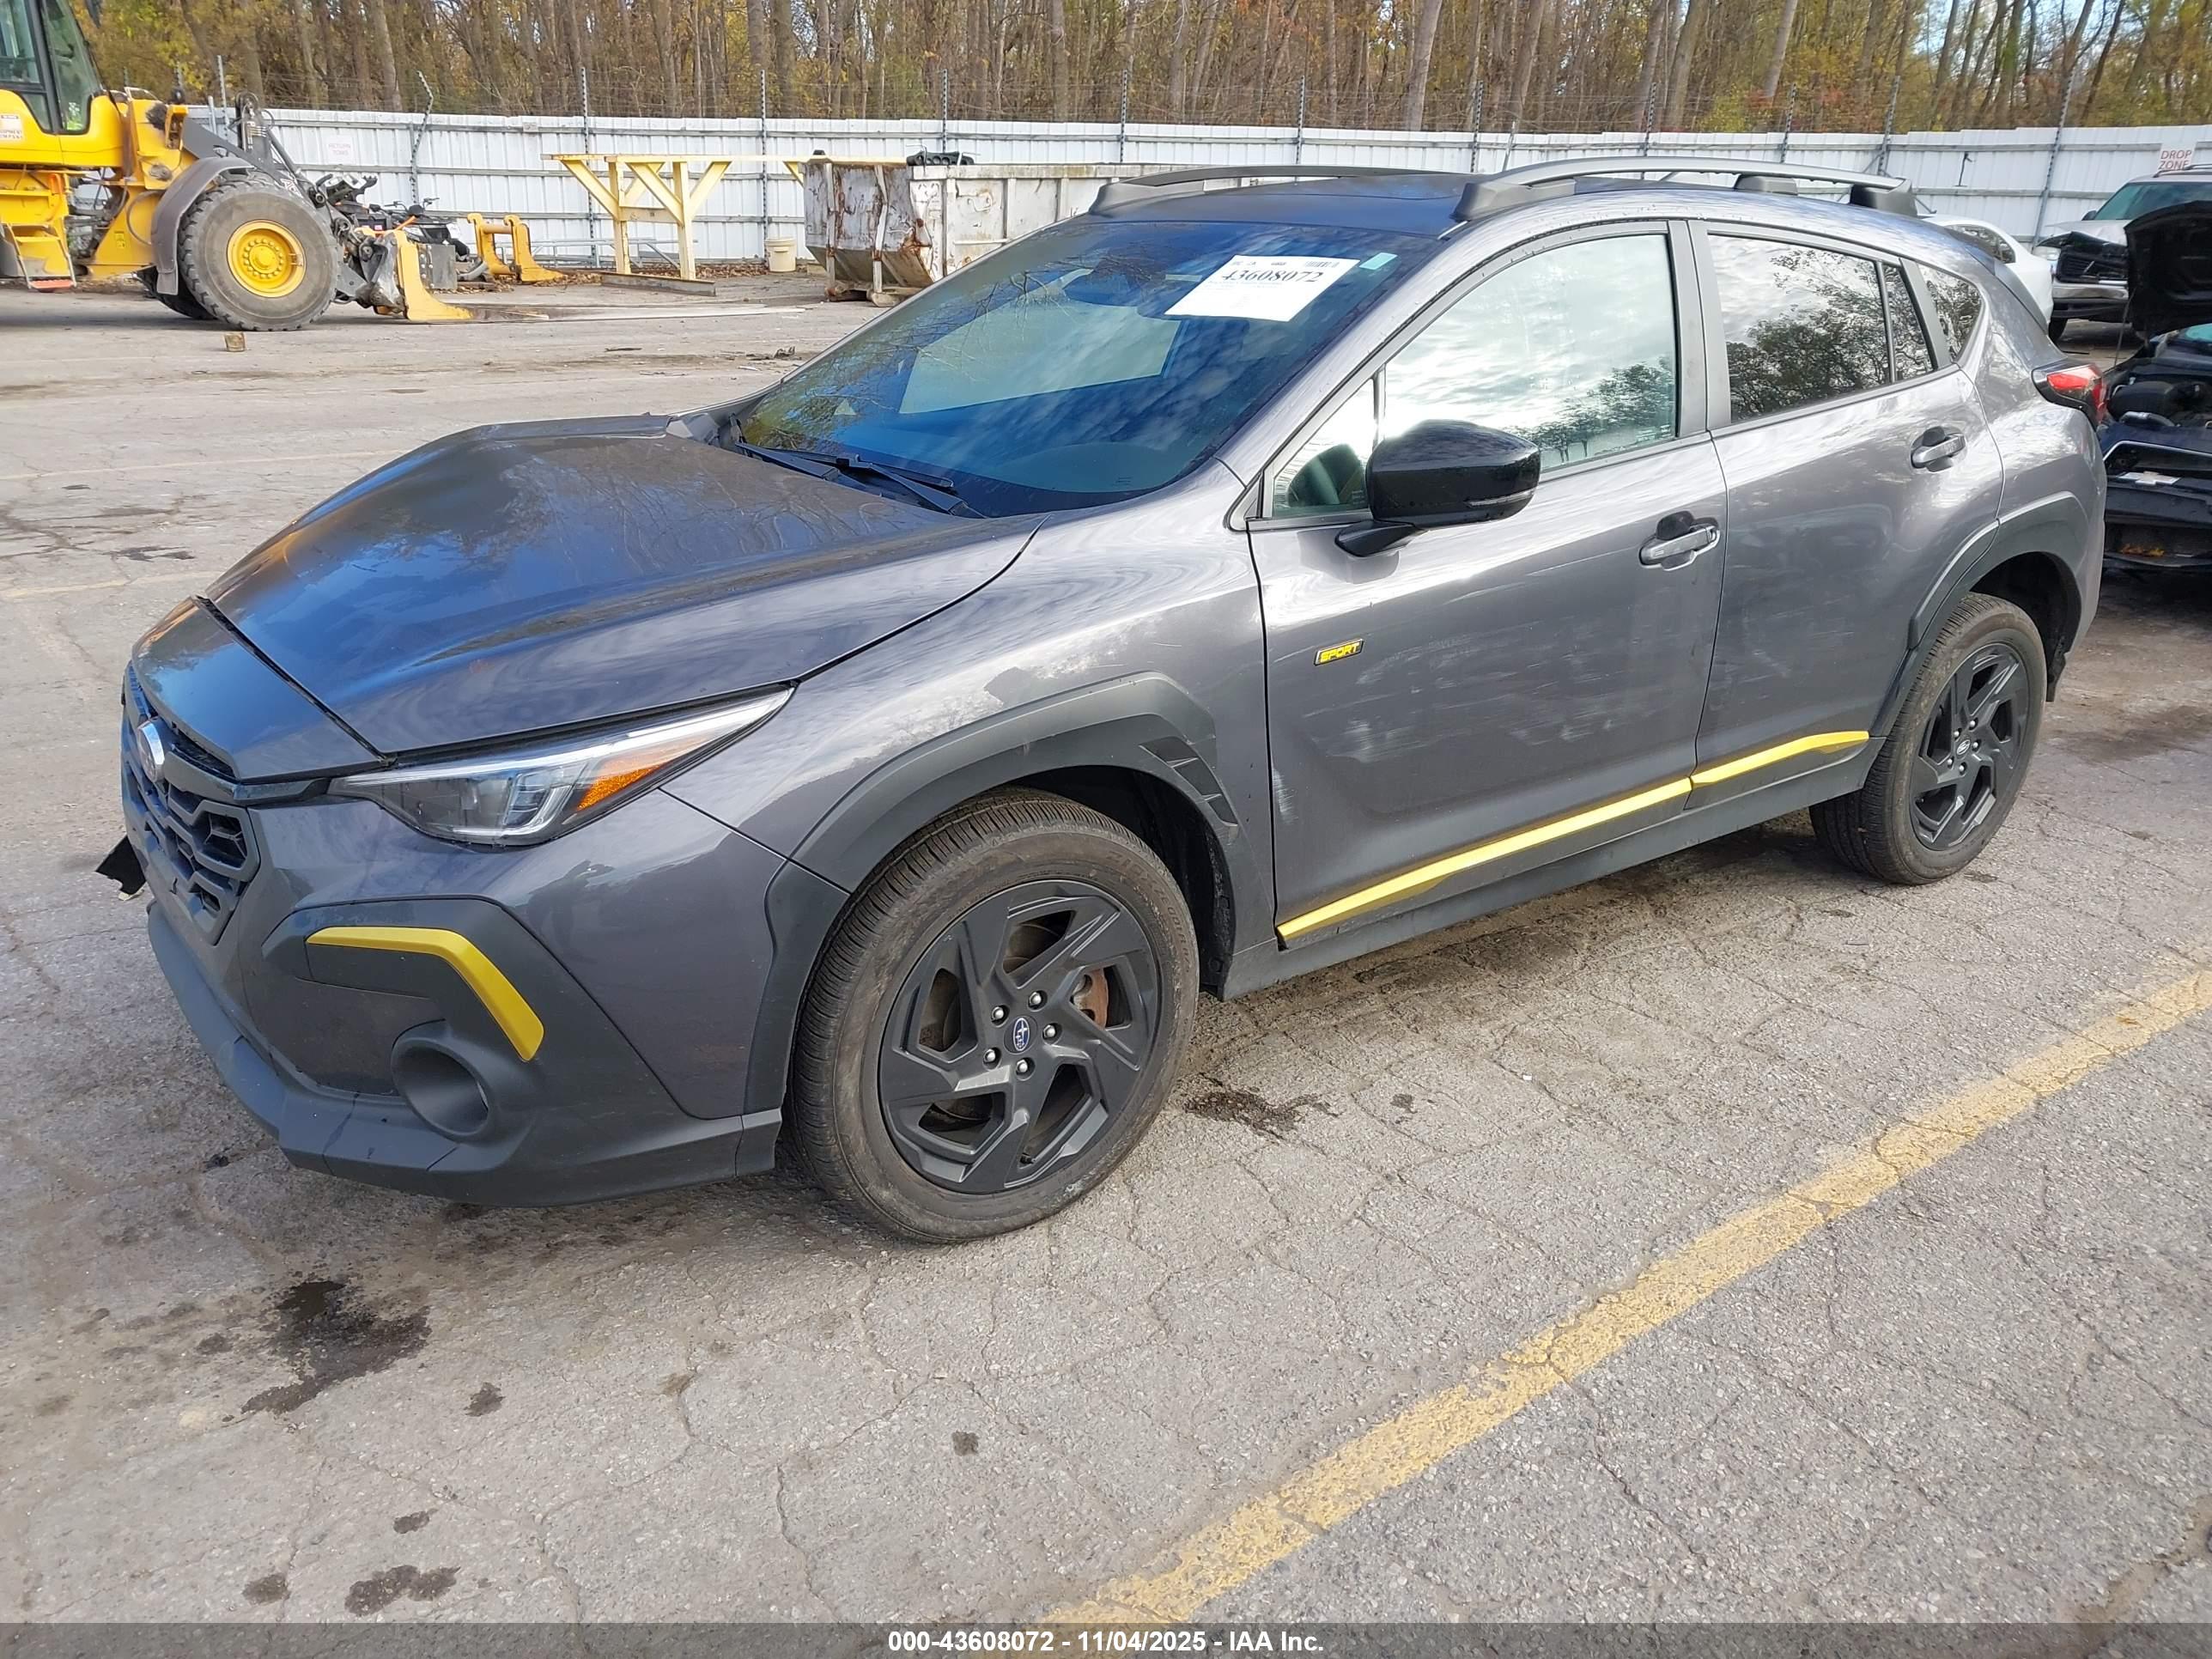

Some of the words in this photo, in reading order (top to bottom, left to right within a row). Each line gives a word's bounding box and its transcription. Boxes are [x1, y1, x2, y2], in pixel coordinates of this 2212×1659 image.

[2160, 149, 2191, 160] DROP
[1222, 270, 1323, 282] 43608072
[1320, 641, 1360, 663] SPORT
